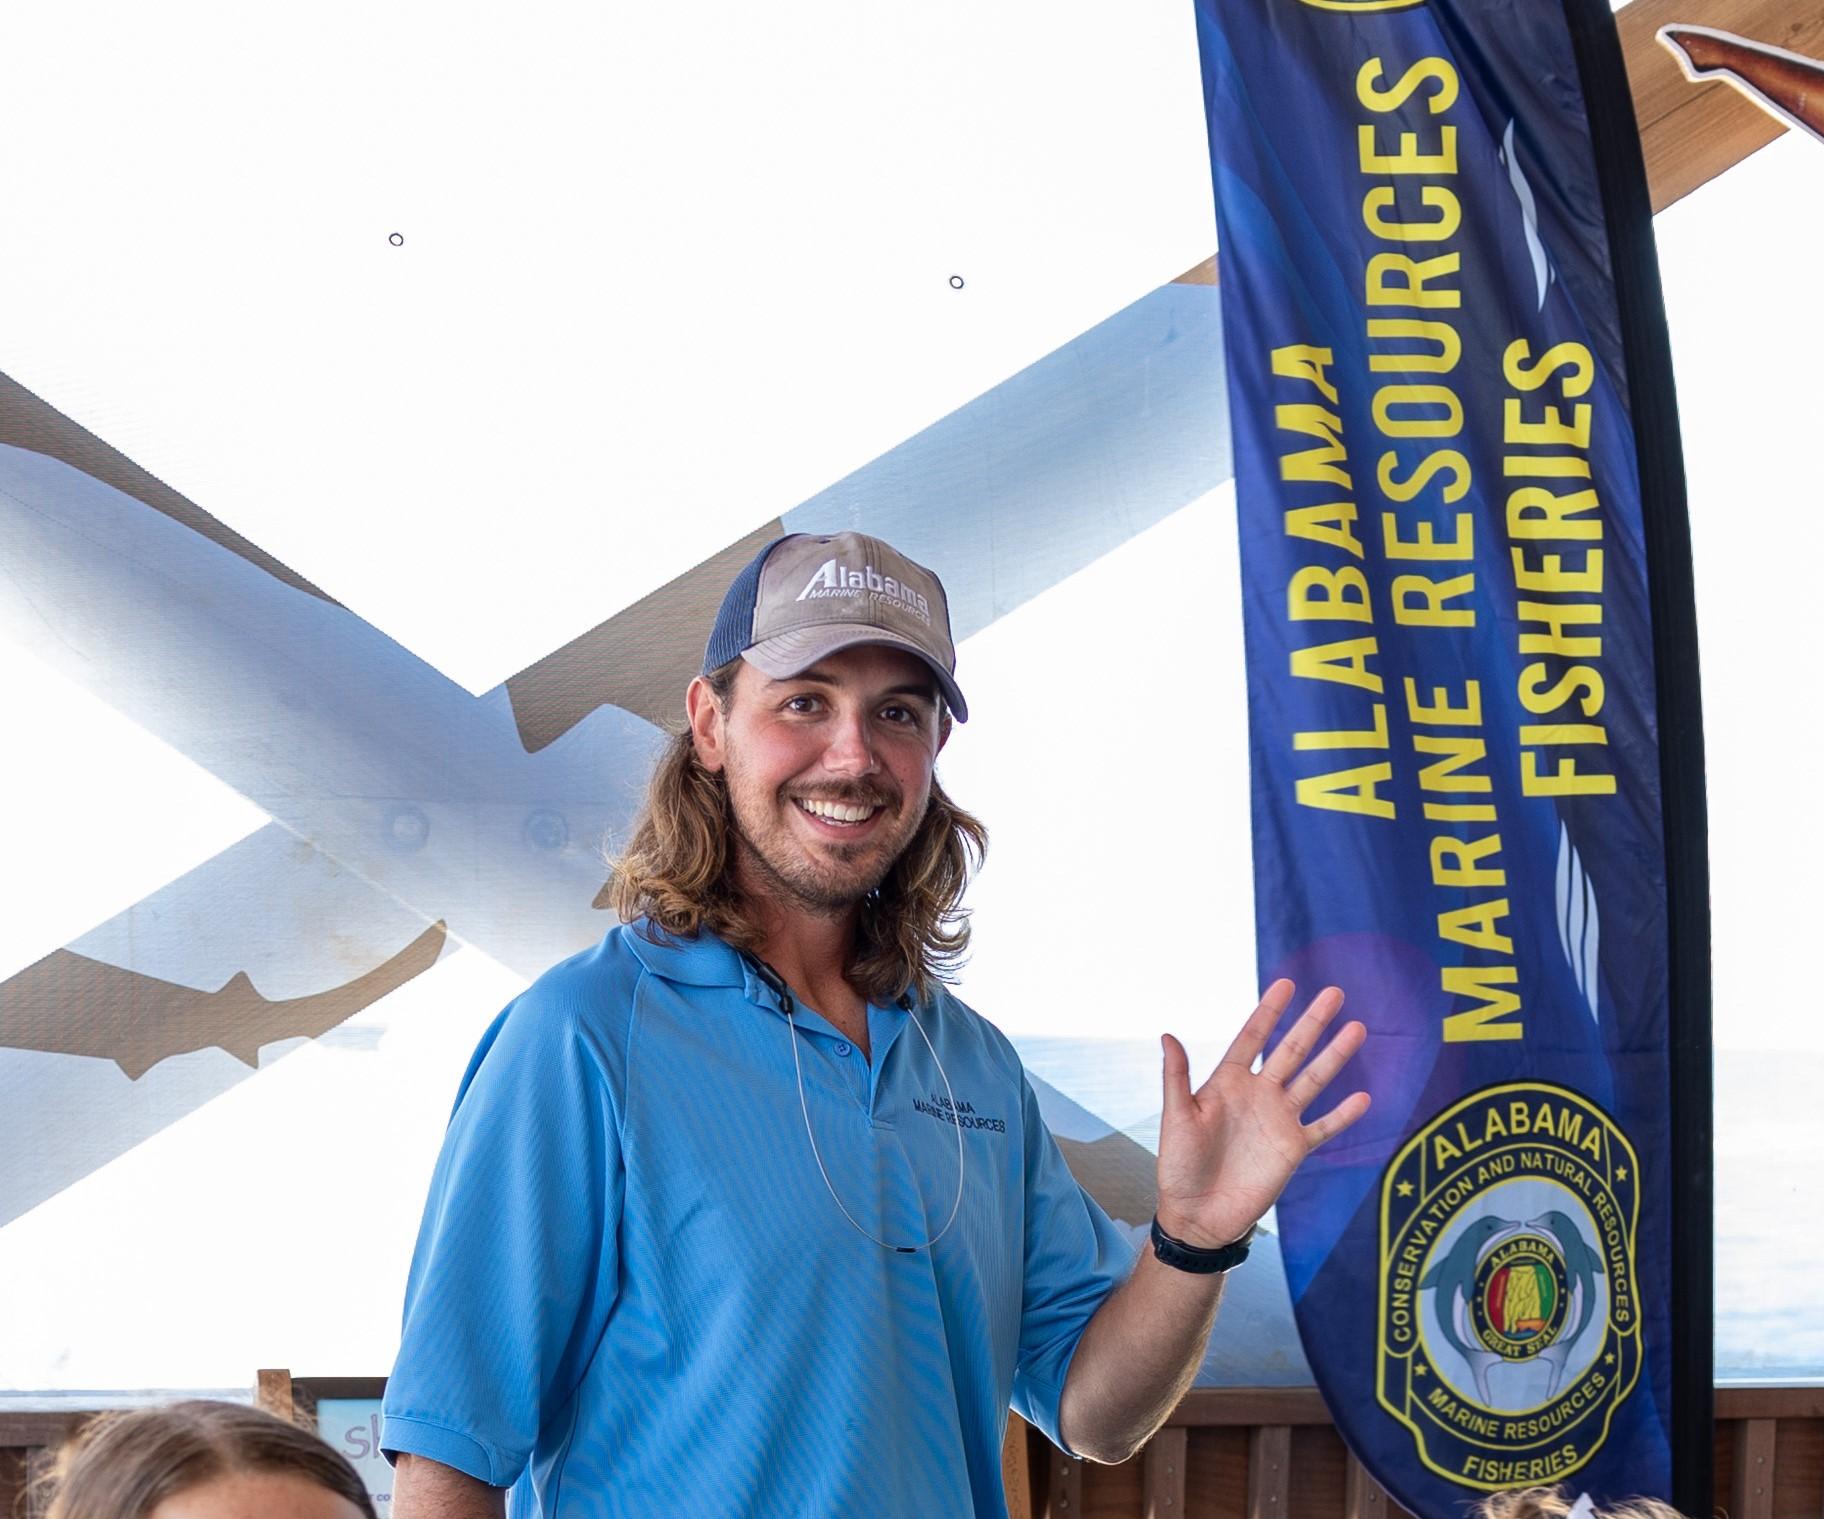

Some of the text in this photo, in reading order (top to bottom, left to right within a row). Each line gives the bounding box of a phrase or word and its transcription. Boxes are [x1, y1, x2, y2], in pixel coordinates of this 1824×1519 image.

[1356, 56, 1523, 1042] MARINE RESOURCES
[1503, 338, 1617, 797] FISHERIES
[796, 559, 929, 616] Alabama
[809, 588, 931, 626] MARINE RESOURCES
[1272, 344, 1396, 820] ALABAMA
[945, 1111, 1006, 1133] RESOURCES
[1433, 1101, 1602, 1170] ALABAMA
[1391, 1152, 1630, 1342] CONSERVATION AND NATURAL RESOURCES
[1491, 1241, 1554, 1267] ALABAMA
[1482, 1326, 1558, 1356] GREAT SEAL
[1427, 1371, 1606, 1439] MARINE RESOURCES
[1462, 1444, 1579, 1482] FISHERIES
